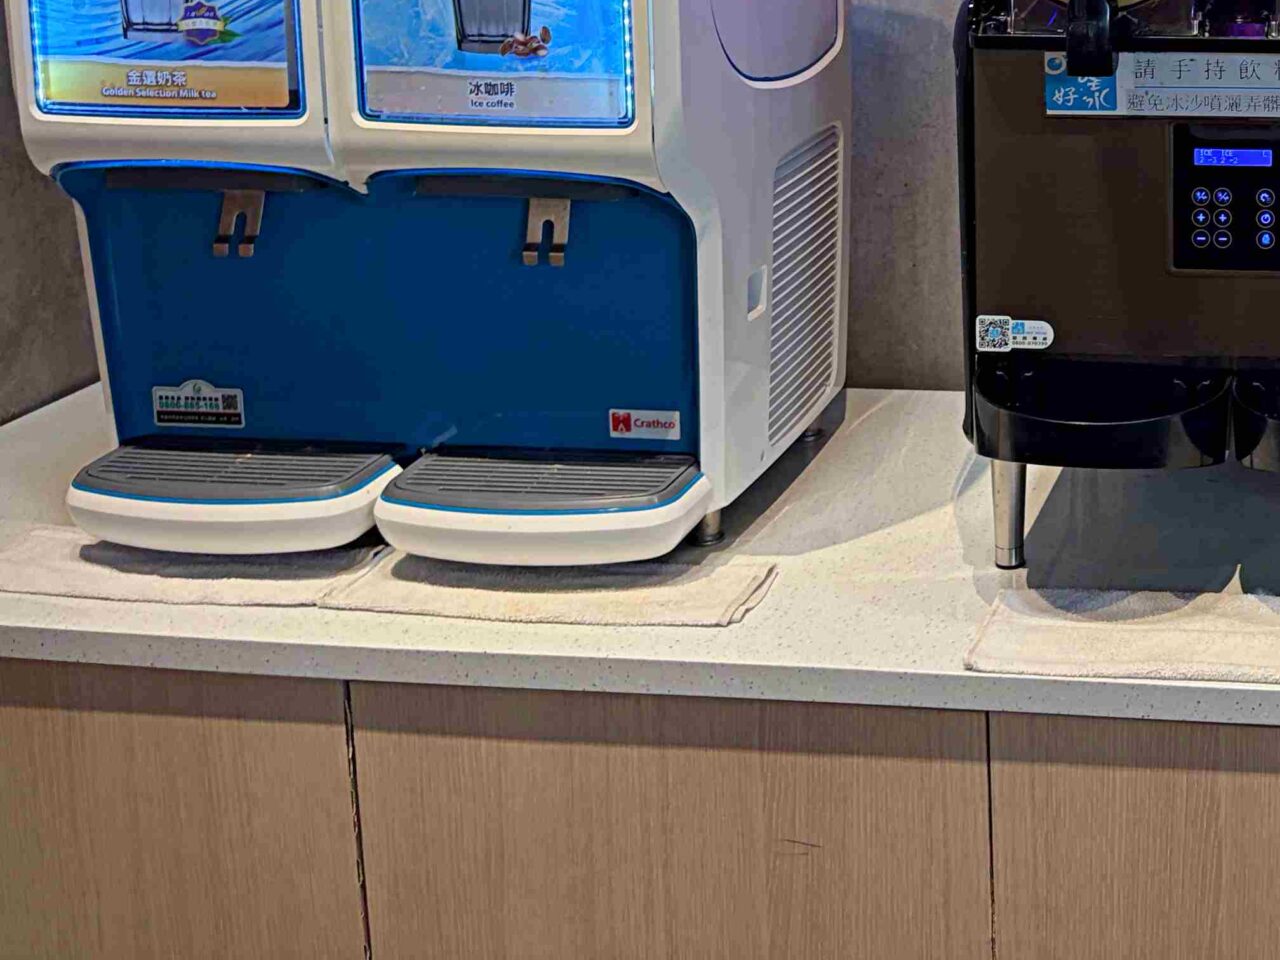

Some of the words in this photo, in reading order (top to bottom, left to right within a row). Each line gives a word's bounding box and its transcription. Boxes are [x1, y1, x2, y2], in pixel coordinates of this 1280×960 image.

[102, 86, 134, 97] Golden
[136, 87, 178, 98] Selection
[180, 88, 200, 99] Milk
[202, 90, 217, 99] tea
[469, 81, 515, 96] 冰咖啡
[471, 99, 484, 108] Ice
[486, 99, 514, 108] coffee
[633, 418, 676, 430] Crathco
